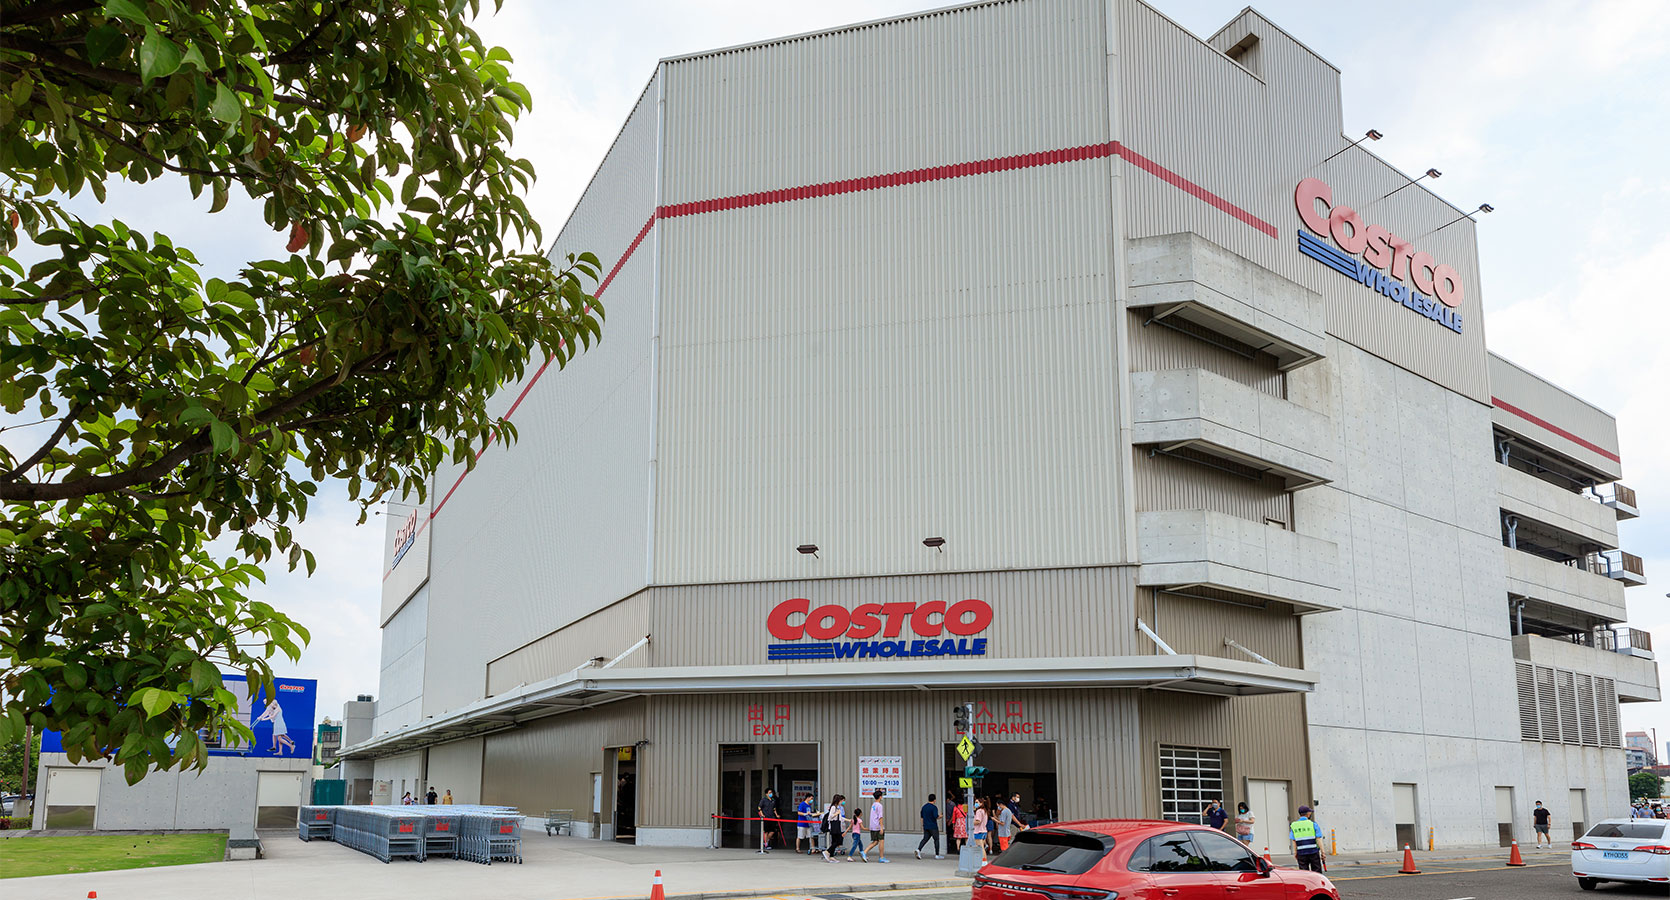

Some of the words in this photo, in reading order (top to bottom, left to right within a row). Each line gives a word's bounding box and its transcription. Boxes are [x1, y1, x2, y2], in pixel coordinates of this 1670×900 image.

[1295, 177, 1464, 307] COSTCO
[1354, 259, 1463, 334] WHOLESALE
[767, 598, 993, 640] COSTCO
[832, 638, 987, 659] WHOLESALE
[748, 703, 790, 722] 出口
[975, 701, 1023, 719] 入口
[753, 724, 784, 736] EXIT
